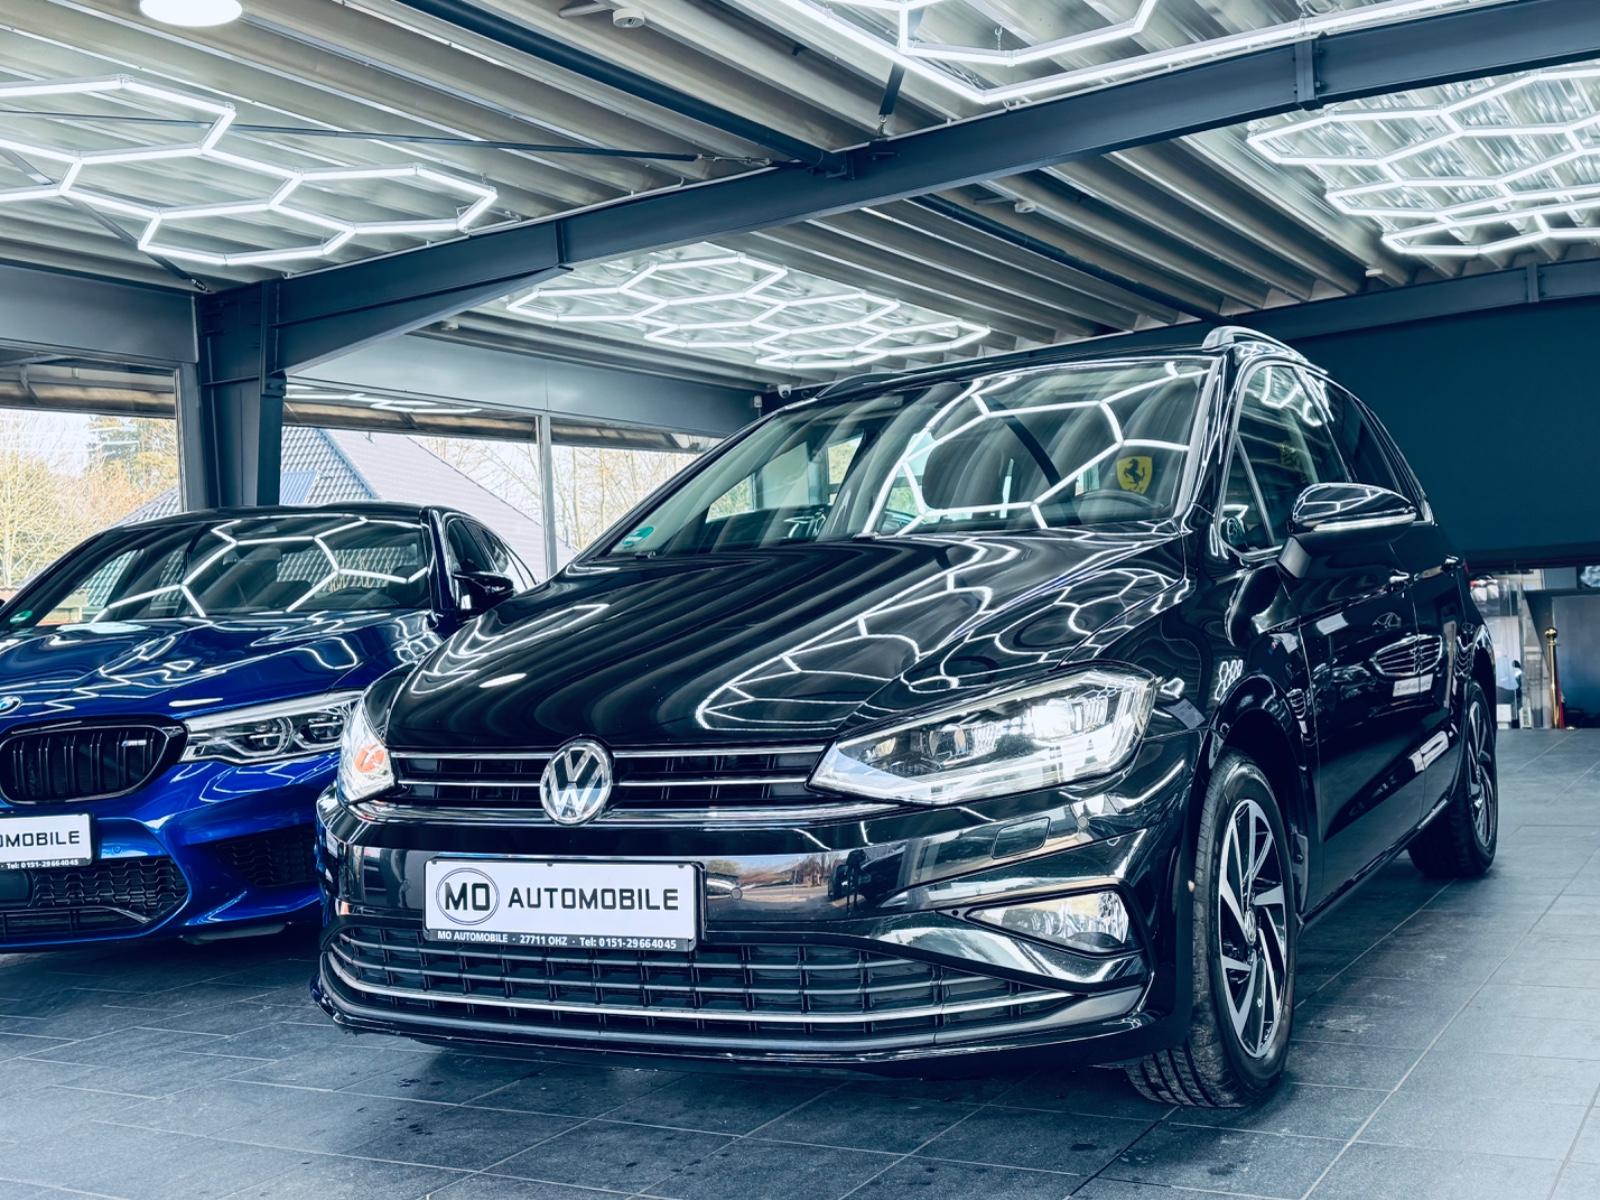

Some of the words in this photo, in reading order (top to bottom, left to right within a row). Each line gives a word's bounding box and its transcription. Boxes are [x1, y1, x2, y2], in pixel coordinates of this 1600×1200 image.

[444, 882, 491, 911] MO
[508, 887, 679, 911] AUTOMOBILE
[437, 930, 452, 940] MO
[453, 931, 508, 943] AUTOMOBILE
[520, 934, 546, 945] 27711
[548, 936, 568, 946] OHZ
[579, 937, 597, 947] Tel:
[598, 937, 677, 949] 0151-29664045
